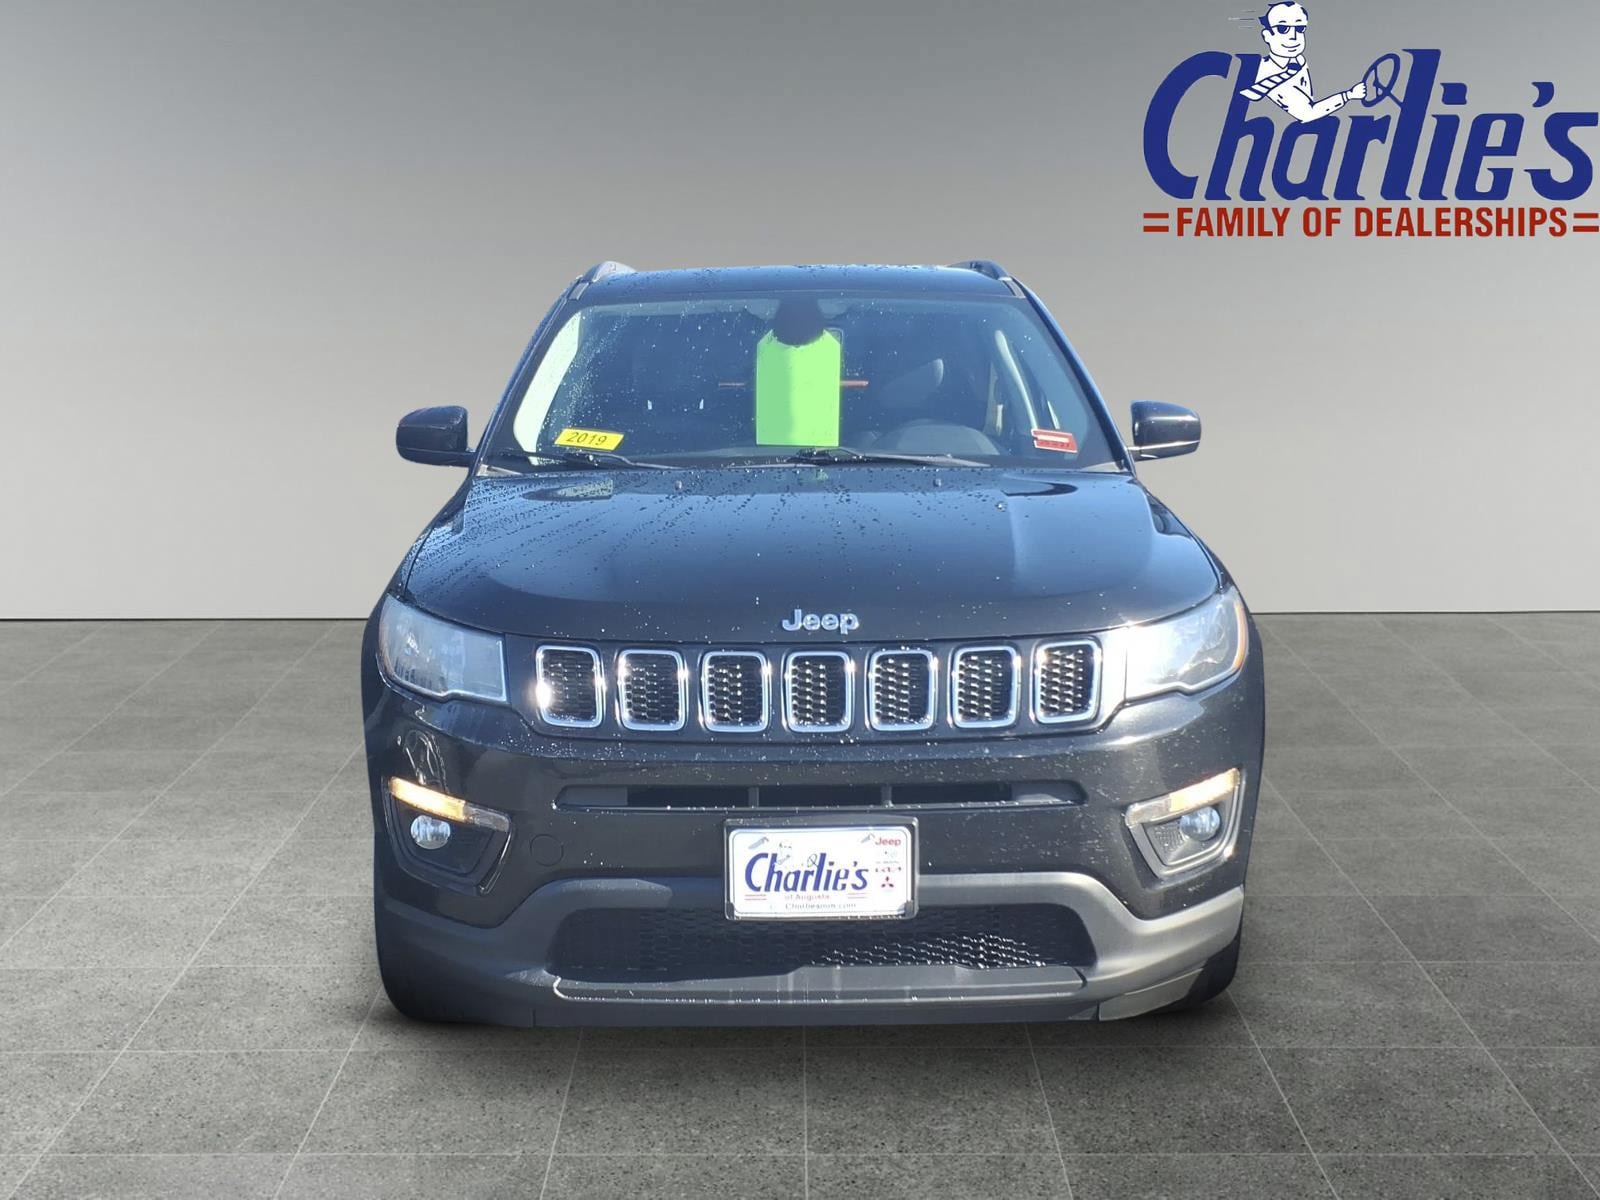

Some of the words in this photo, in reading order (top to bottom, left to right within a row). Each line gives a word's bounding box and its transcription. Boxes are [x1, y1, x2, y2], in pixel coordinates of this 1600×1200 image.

[566, 431, 608, 445] 2019
[781, 608, 860, 635] Jeep
[875, 837, 902, 847] Jeep
[745, 852, 869, 892] Charlie's
